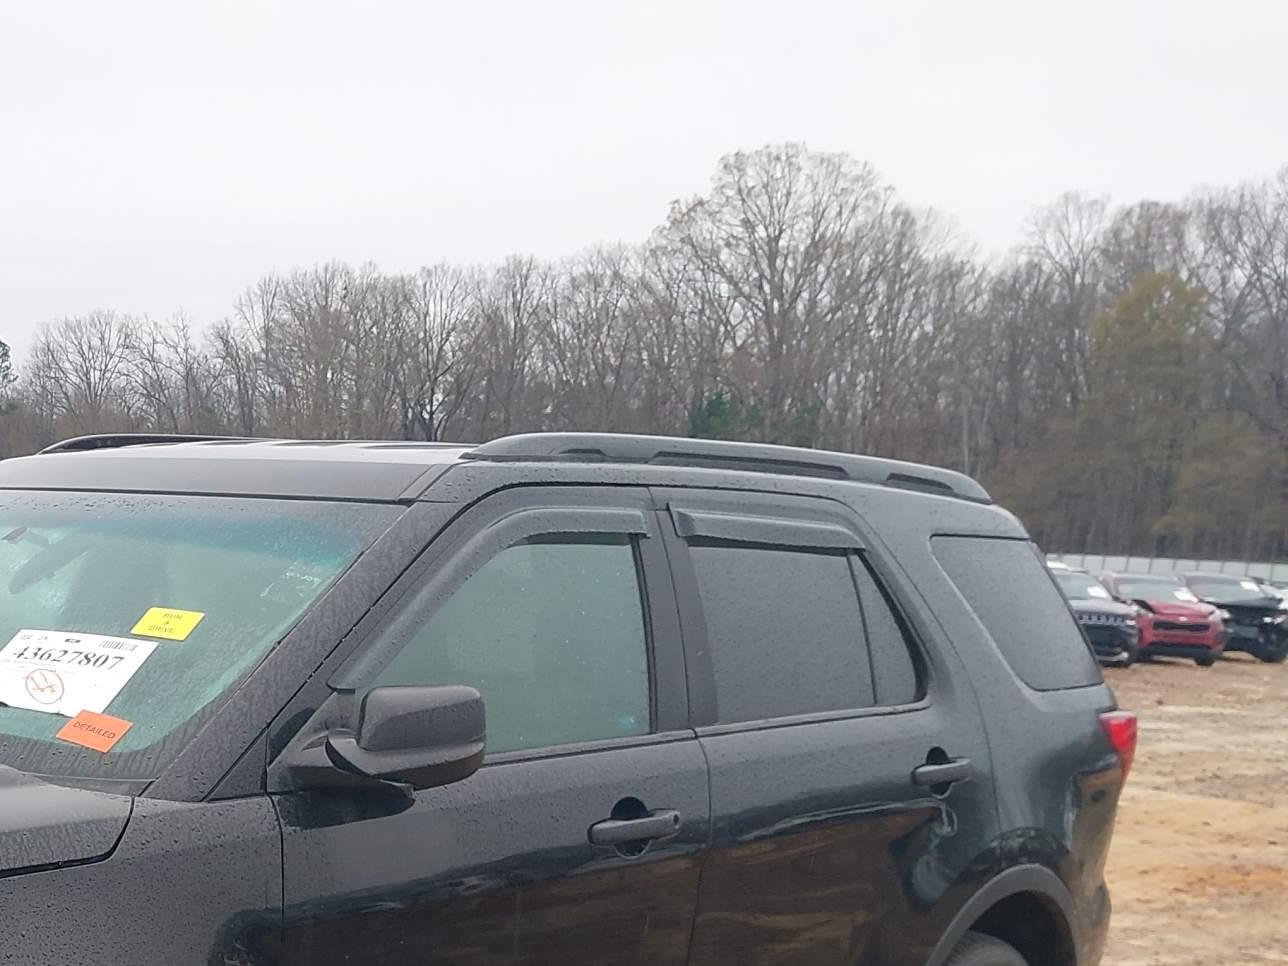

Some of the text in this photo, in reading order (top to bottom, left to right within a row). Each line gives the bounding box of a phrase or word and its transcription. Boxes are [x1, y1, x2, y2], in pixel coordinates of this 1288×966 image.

[148, 625, 176, 634] DRIVE
[14, 646, 125, 670] 43627807
[73, 721, 116, 739] DETAILED
